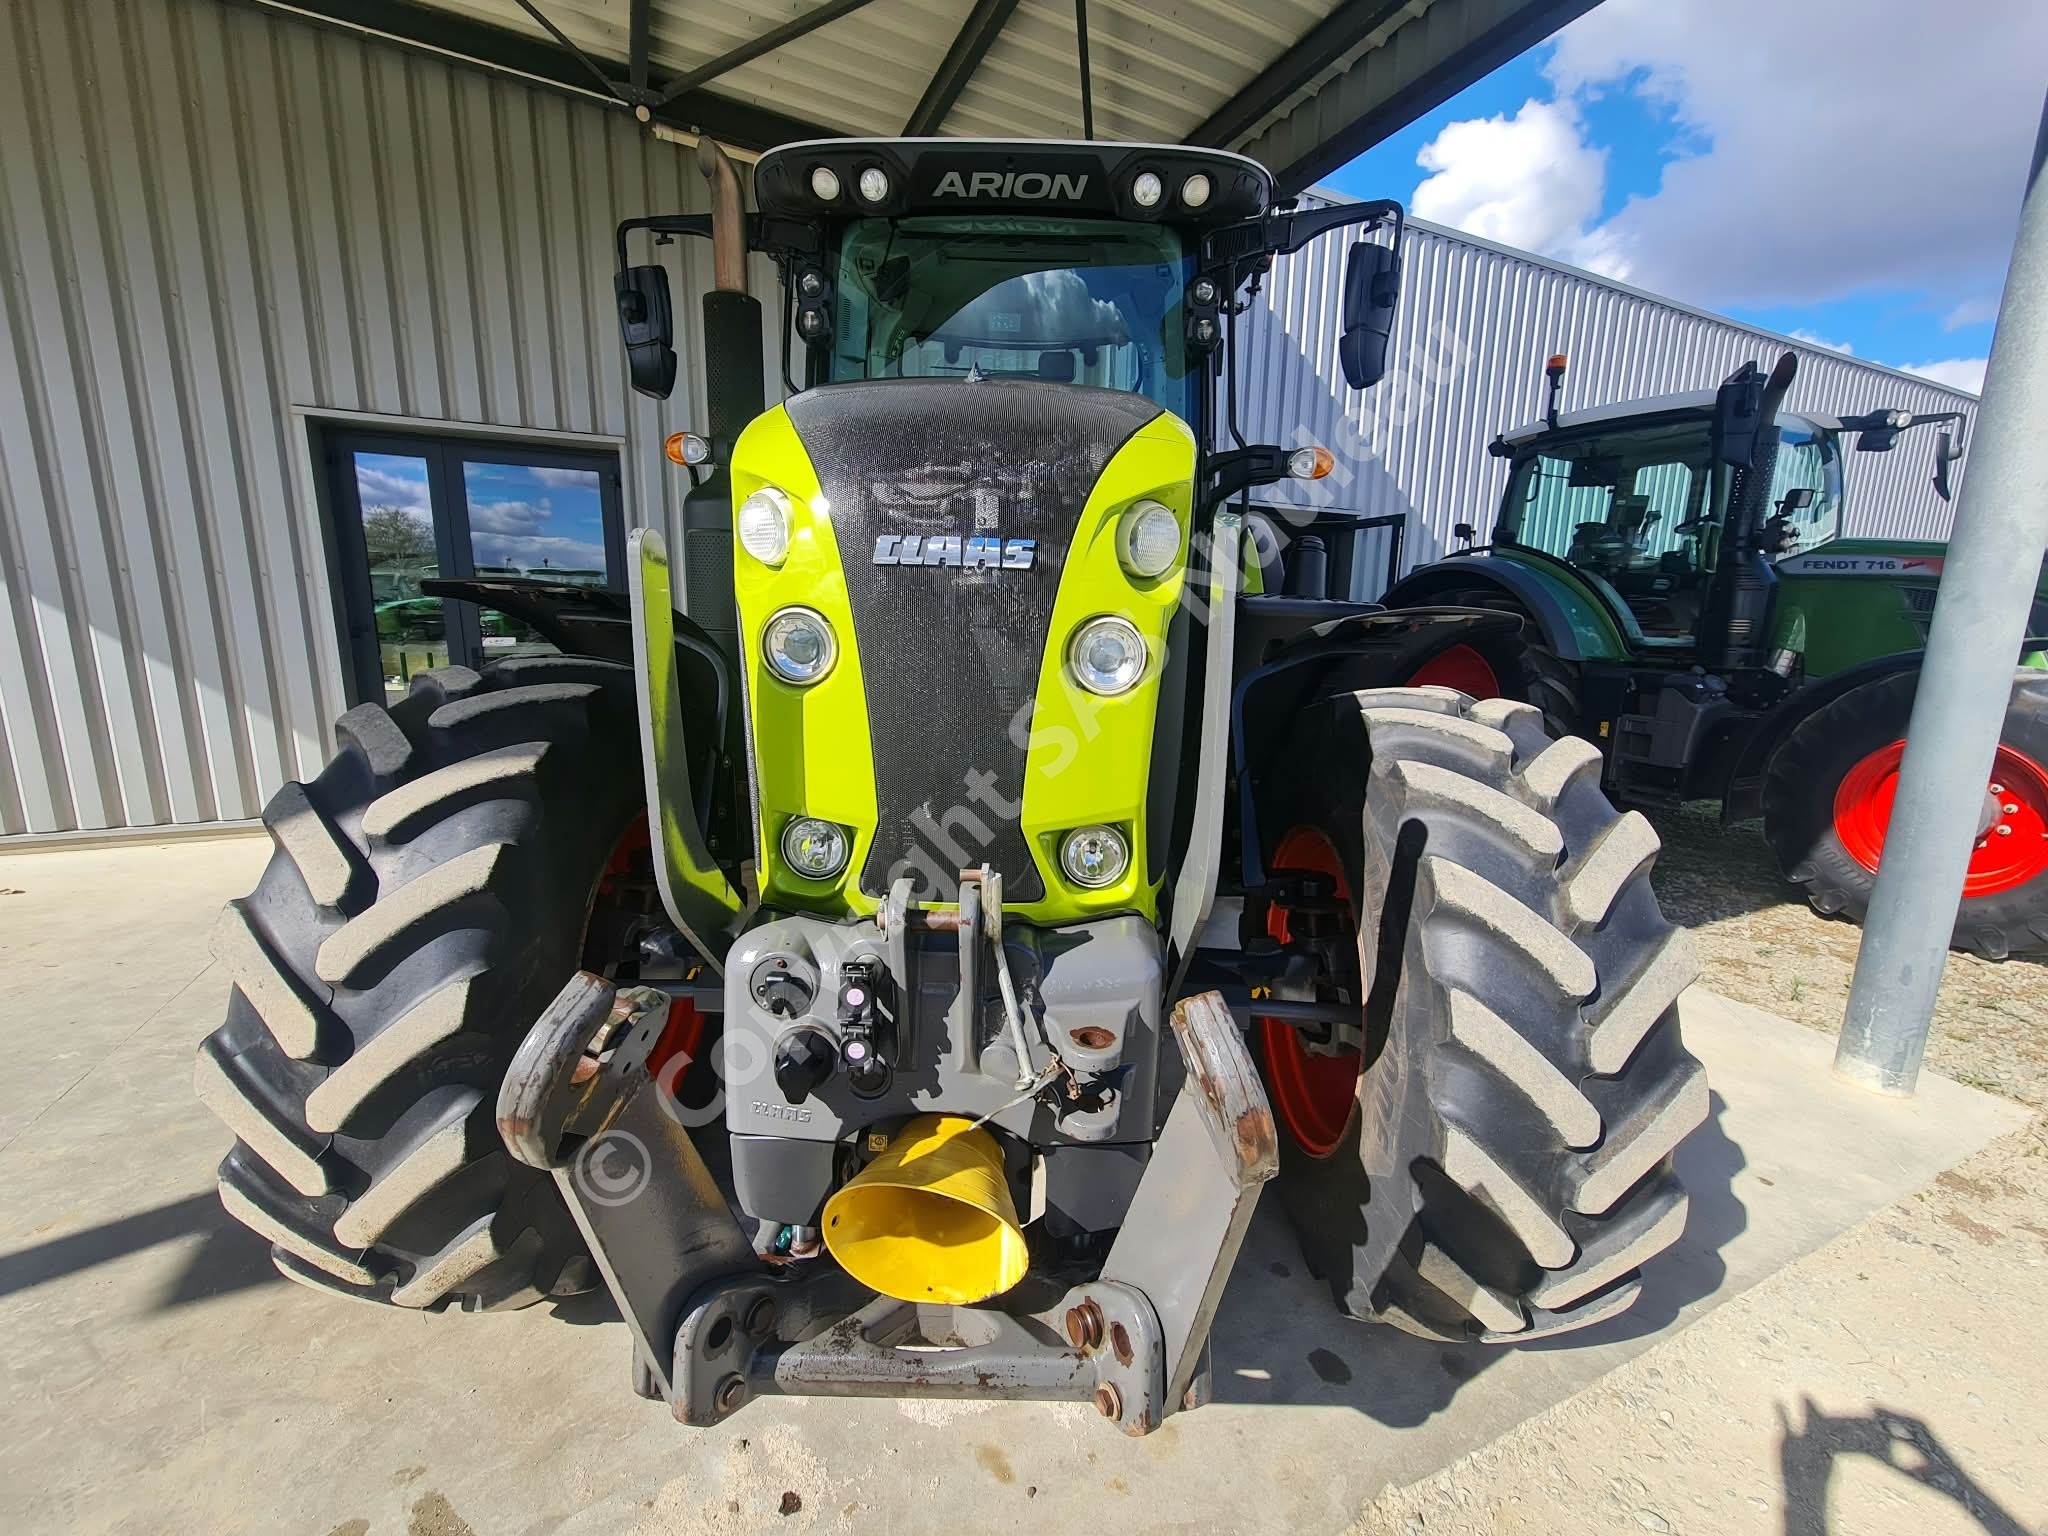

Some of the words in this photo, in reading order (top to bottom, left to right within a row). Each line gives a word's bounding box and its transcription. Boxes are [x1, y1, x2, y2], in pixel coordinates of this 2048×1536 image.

[932, 171, 1089, 200] ARION
[873, 535, 1037, 569] CLAAS
[1803, 560, 1859, 570] FENDT
[1866, 560, 1897, 570] 716
[752, 1101, 811, 1122] CLAAS
